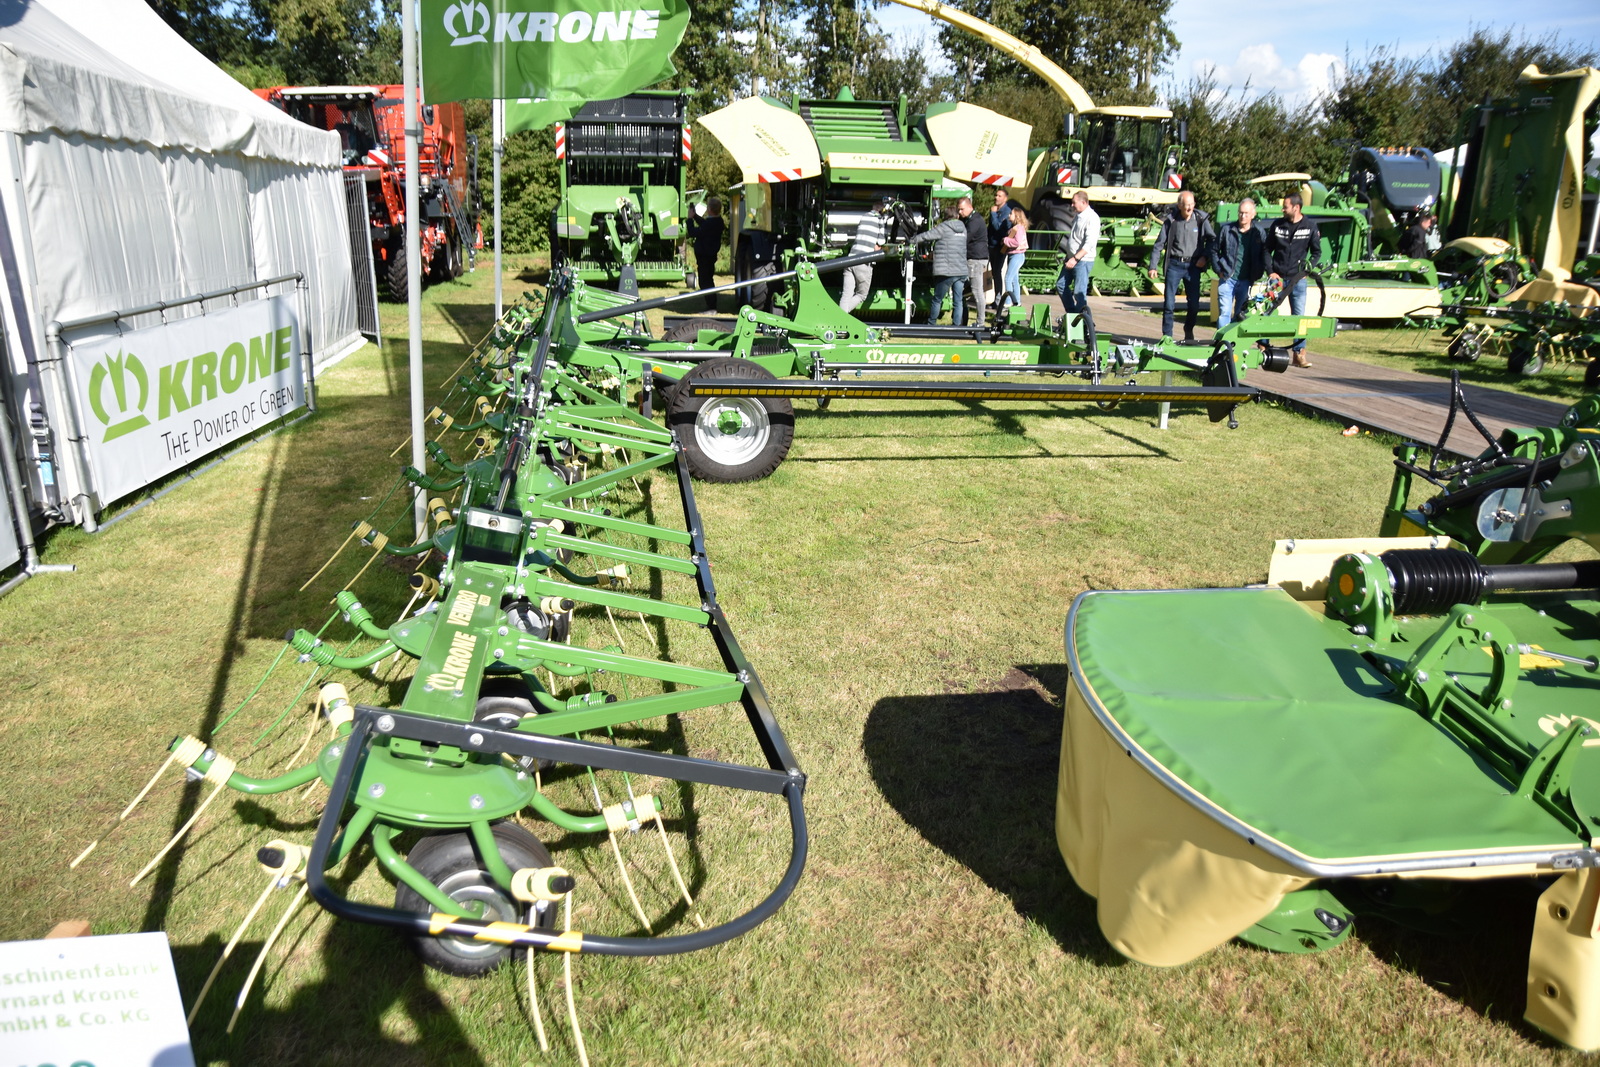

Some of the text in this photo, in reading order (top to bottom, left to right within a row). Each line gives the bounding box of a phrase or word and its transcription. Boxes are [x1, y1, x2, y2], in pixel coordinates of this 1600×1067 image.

[494, 10, 661, 43] KRONE
[885, 353, 945, 364] KRONE
[978, 350, 1029, 360] VENDRO
[158, 325, 293, 421] KRONE
[442, 589, 479, 678] KRONE VENDRO
[0, 963, 160, 986] schinenfabrik
[0, 988, 140, 1009] rnard Krone
[0, 1015, 48, 1033] mbH
[56, 1013, 72, 1028] &
[121, 1008, 151, 1024] KG
